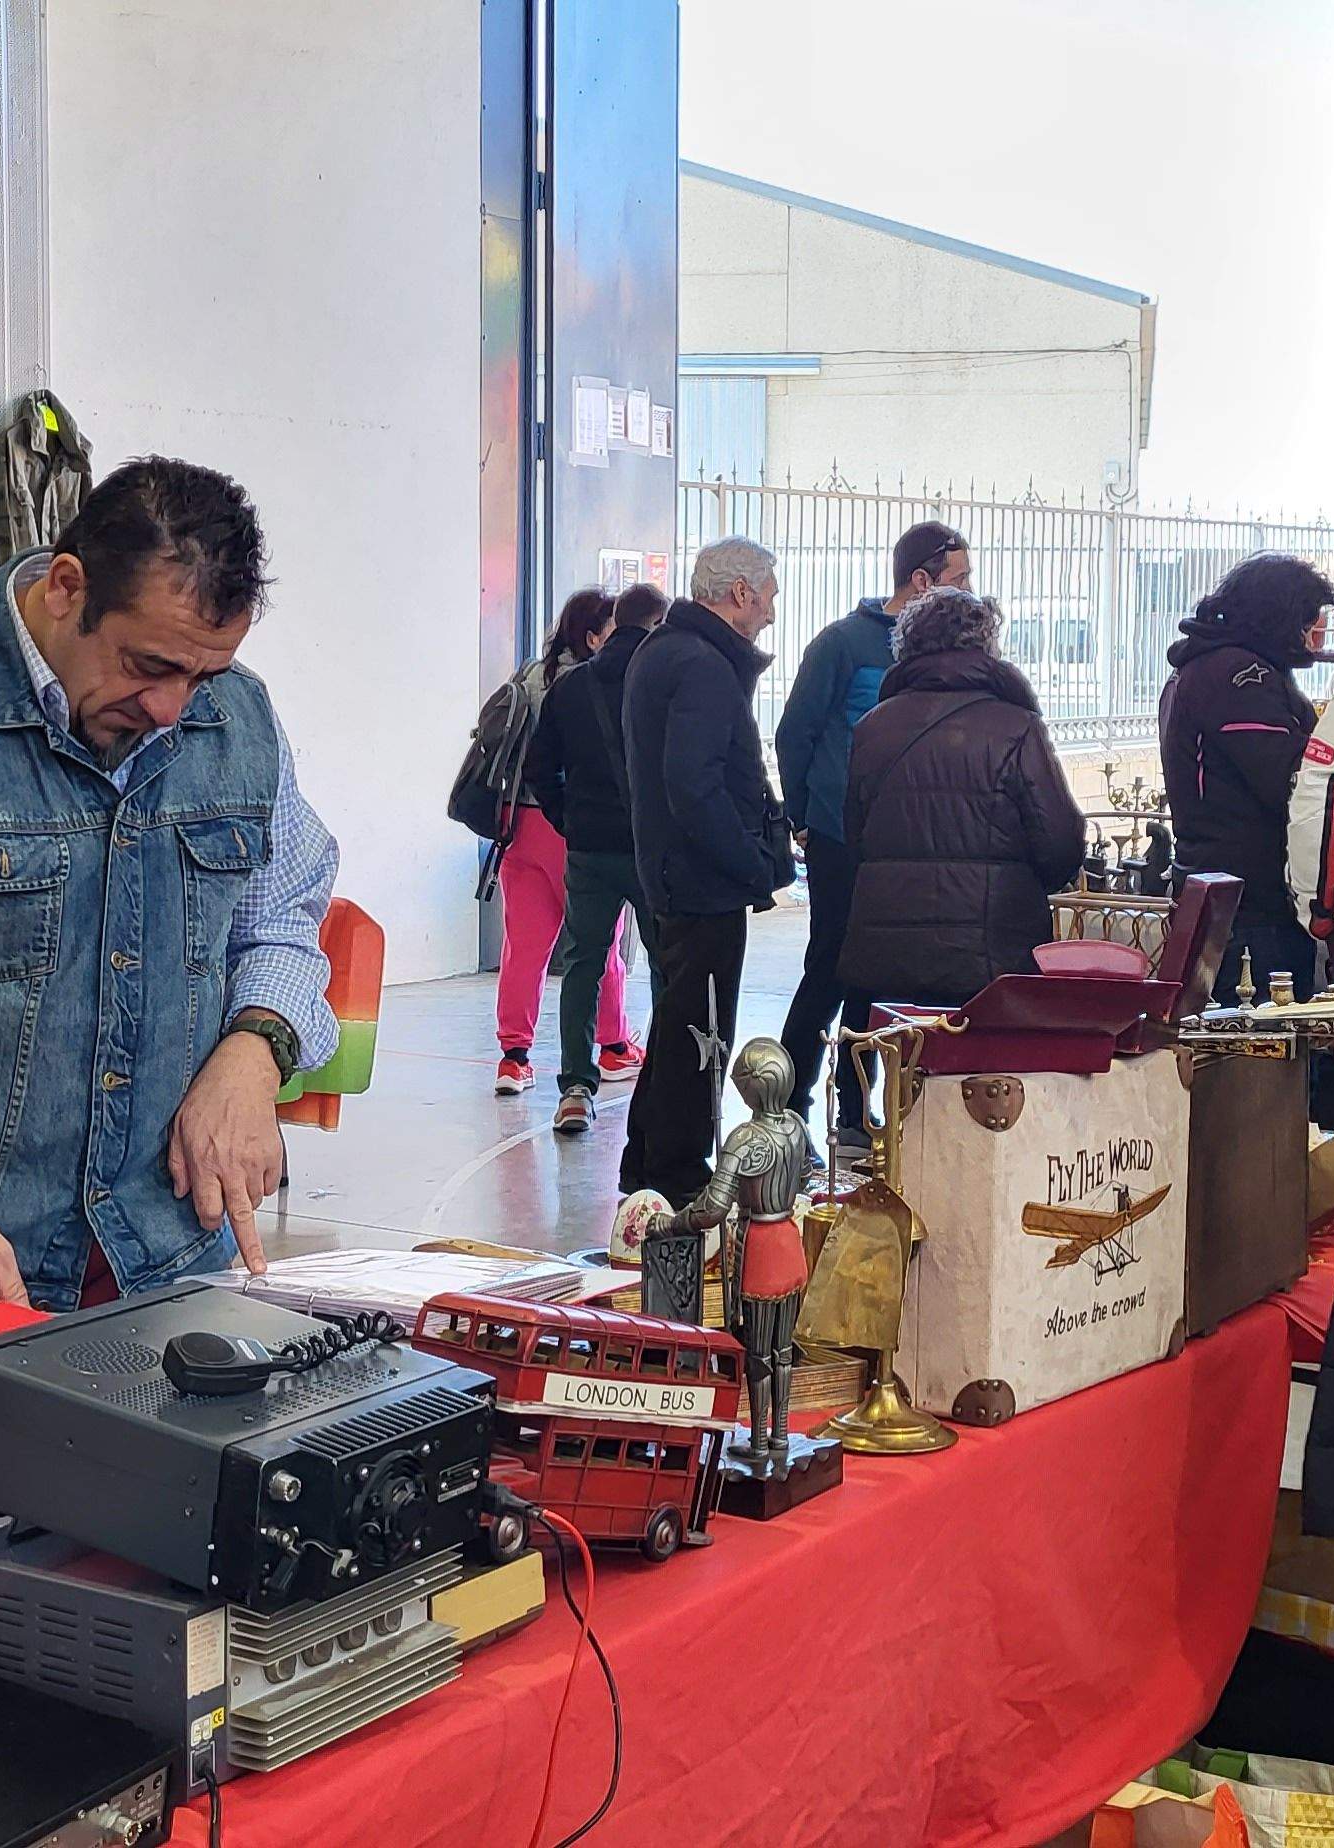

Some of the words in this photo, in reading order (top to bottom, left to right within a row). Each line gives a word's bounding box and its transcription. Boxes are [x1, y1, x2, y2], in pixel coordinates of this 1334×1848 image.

[1047, 1154, 1075, 1206] FLY
[1076, 1149, 1104, 1200] THE
[1108, 1137, 1153, 1180] WORLD
[1044, 1305, 1088, 1338] Above
[1090, 1301, 1108, 1323] the
[1111, 1286, 1147, 1317] crowd
[564, 1381, 648, 1408] LONDON
[660, 1390, 696, 1410] BUS
